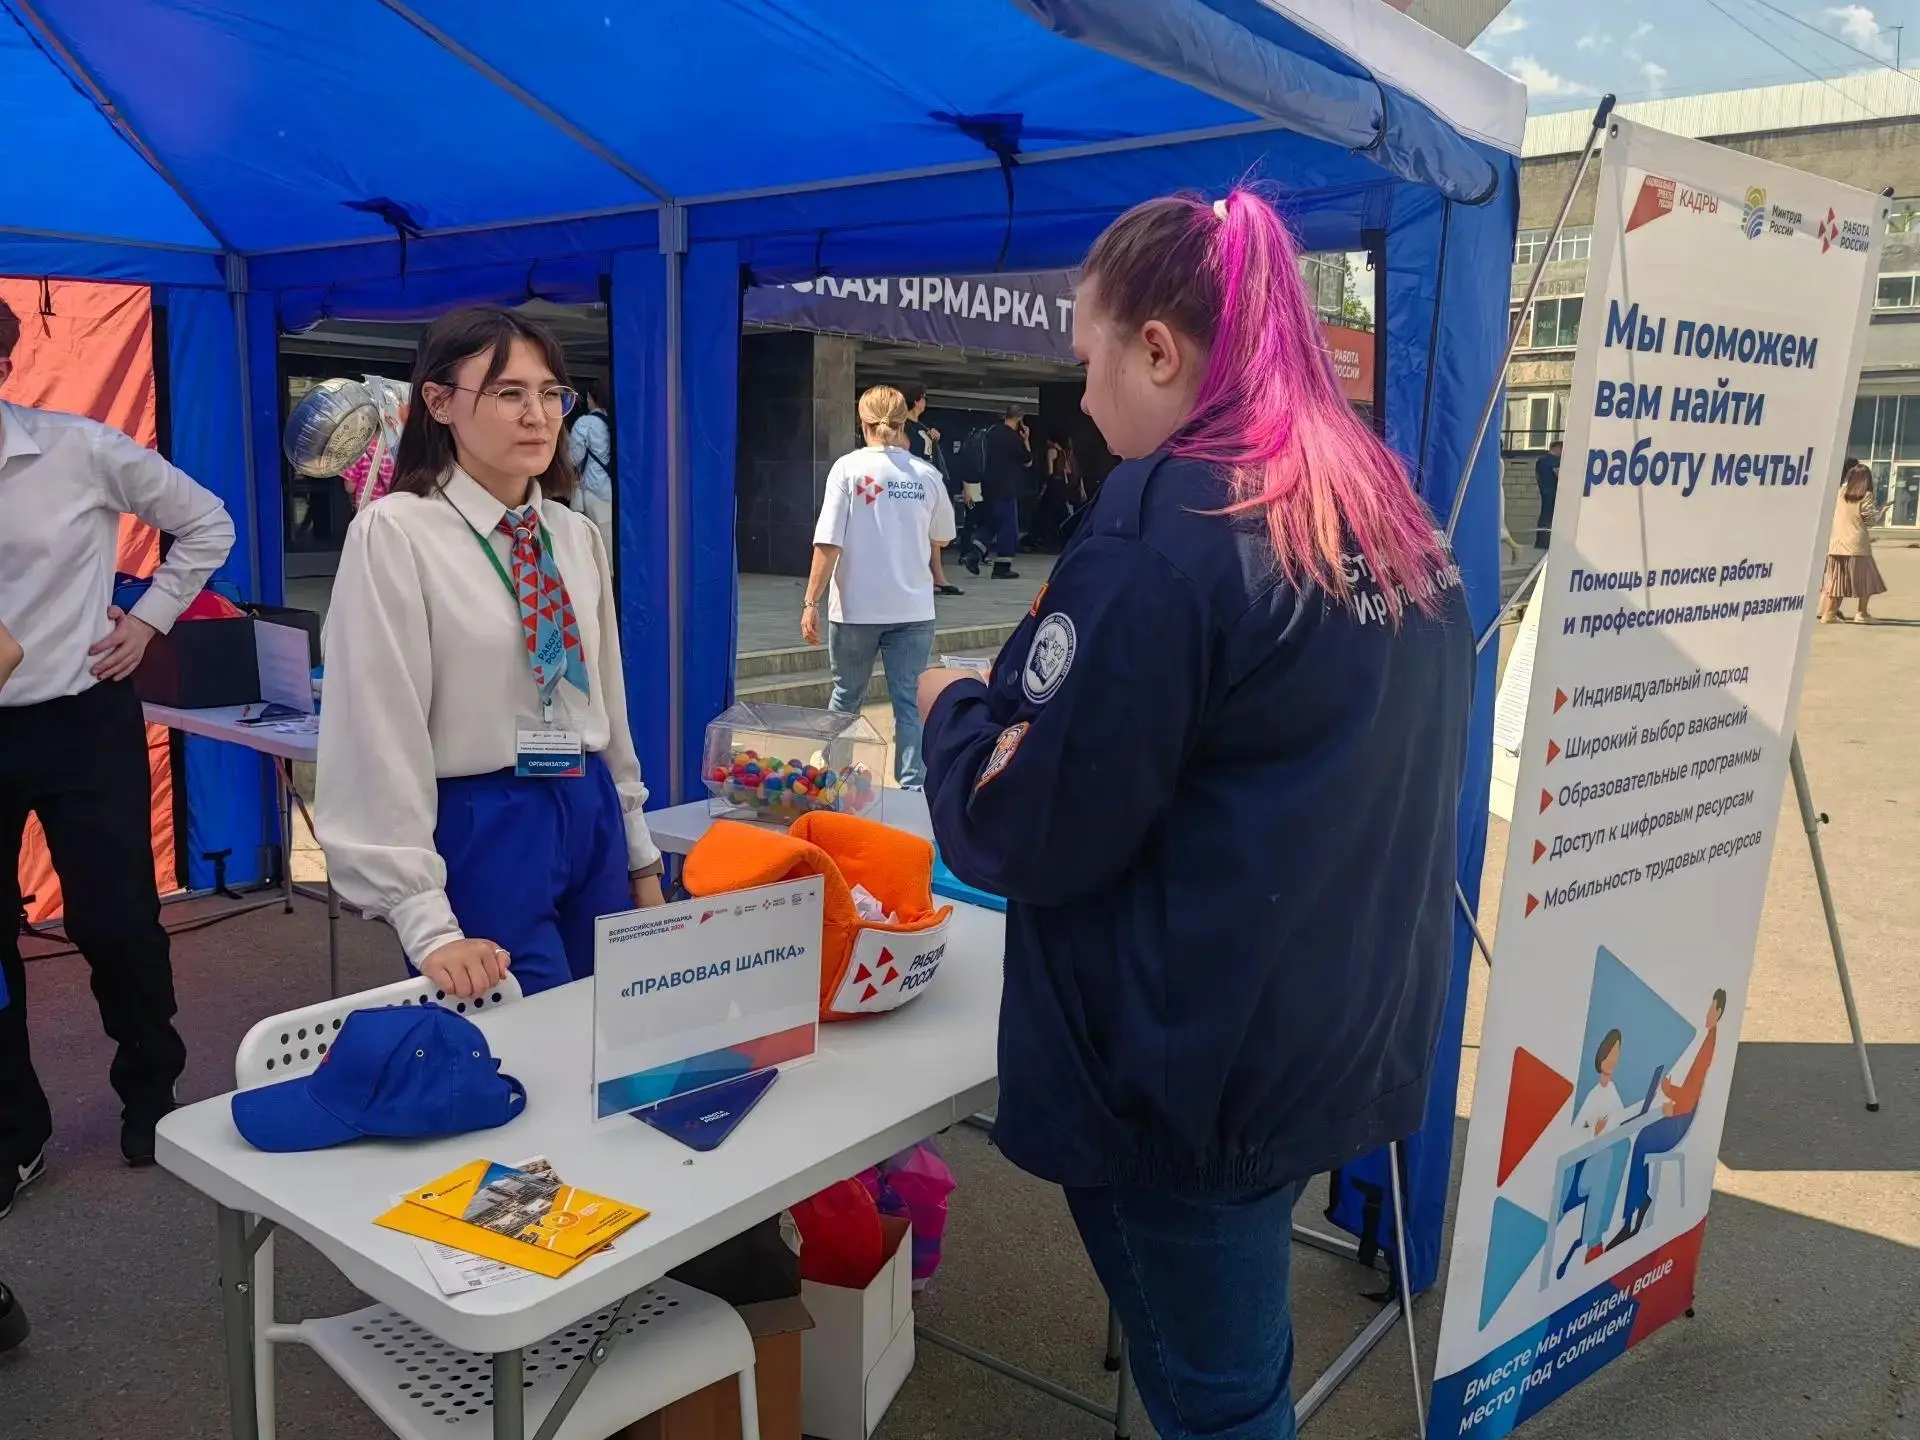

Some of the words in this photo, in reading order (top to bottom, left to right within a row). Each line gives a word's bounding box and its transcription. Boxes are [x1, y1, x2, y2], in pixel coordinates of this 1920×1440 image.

[1679, 188, 1719, 214] КАДРЫ
[1772, 204, 1802, 225] Минтруд
[1769, 220, 1794, 237] России
[1839, 235, 1870, 254] РОССИИ
[1842, 219, 1870, 237] РАБОТА
[899, 277, 1050, 330] ЯРМАРКА
[1604, 299, 1666, 353] Мы
[1673, 319, 1819, 369] поможем
[1334, 349, 1359, 365] РАБОТА
[1594, 380, 1663, 421] вам
[1669, 377, 1765, 426] найти
[887, 481, 924, 490] РАБОТА
[1582, 437, 1706, 498] работу
[1710, 446, 1814, 487] мечты!
[888, 490, 925, 500] РОССИИ
[1569, 569, 1643, 592] Помощь
[1646, 569, 1657, 587] в
[1660, 565, 1717, 586] поиске
[1719, 558, 1773, 587] работы
[1563, 616, 1576, 635] и
[1579, 602, 1740, 638] профессиональном
[1742, 594, 1805, 621] развитии
[1572, 668, 1701, 708] Индивидуальный
[1703, 665, 1749, 688] подход
[1565, 725, 1638, 759] Широкий
[1640, 718, 1685, 745] выбор
[1688, 705, 1749, 736] вакансий
[1558, 763, 1688, 807] Образовательные
[1690, 747, 1762, 780] программы
[1549, 826, 1605, 861] Доступ
[1608, 825, 1617, 842] к
[1620, 805, 1693, 843] цифровым
[1695, 789, 1755, 822] ресурсам
[1544, 866, 1642, 910] Мобильность
[1644, 848, 1707, 882] трудовых
[1708, 830, 1762, 864] ресурсов
[608, 920, 663, 937] ВСЕРОССИЙСКАЯ
[663, 914, 693, 925] ЯРМАРКА
[608, 927, 670, 944] ТРУДОУСТРОЙСТВА
[621, 959, 731, 998] «ПРАВОВАЯ
[736, 944, 806, 970] ШАПКА»
[1463, 1347, 1532, 1406] Вместе
[1535, 1327, 1563, 1358] мы
[1566, 1288, 1630, 1338] найдем
[1632, 1257, 1674, 1296] ваше
[1458, 1385, 1516, 1436] место
[1519, 1359, 1554, 1396] под
[1556, 1306, 1635, 1369] солнцем!
